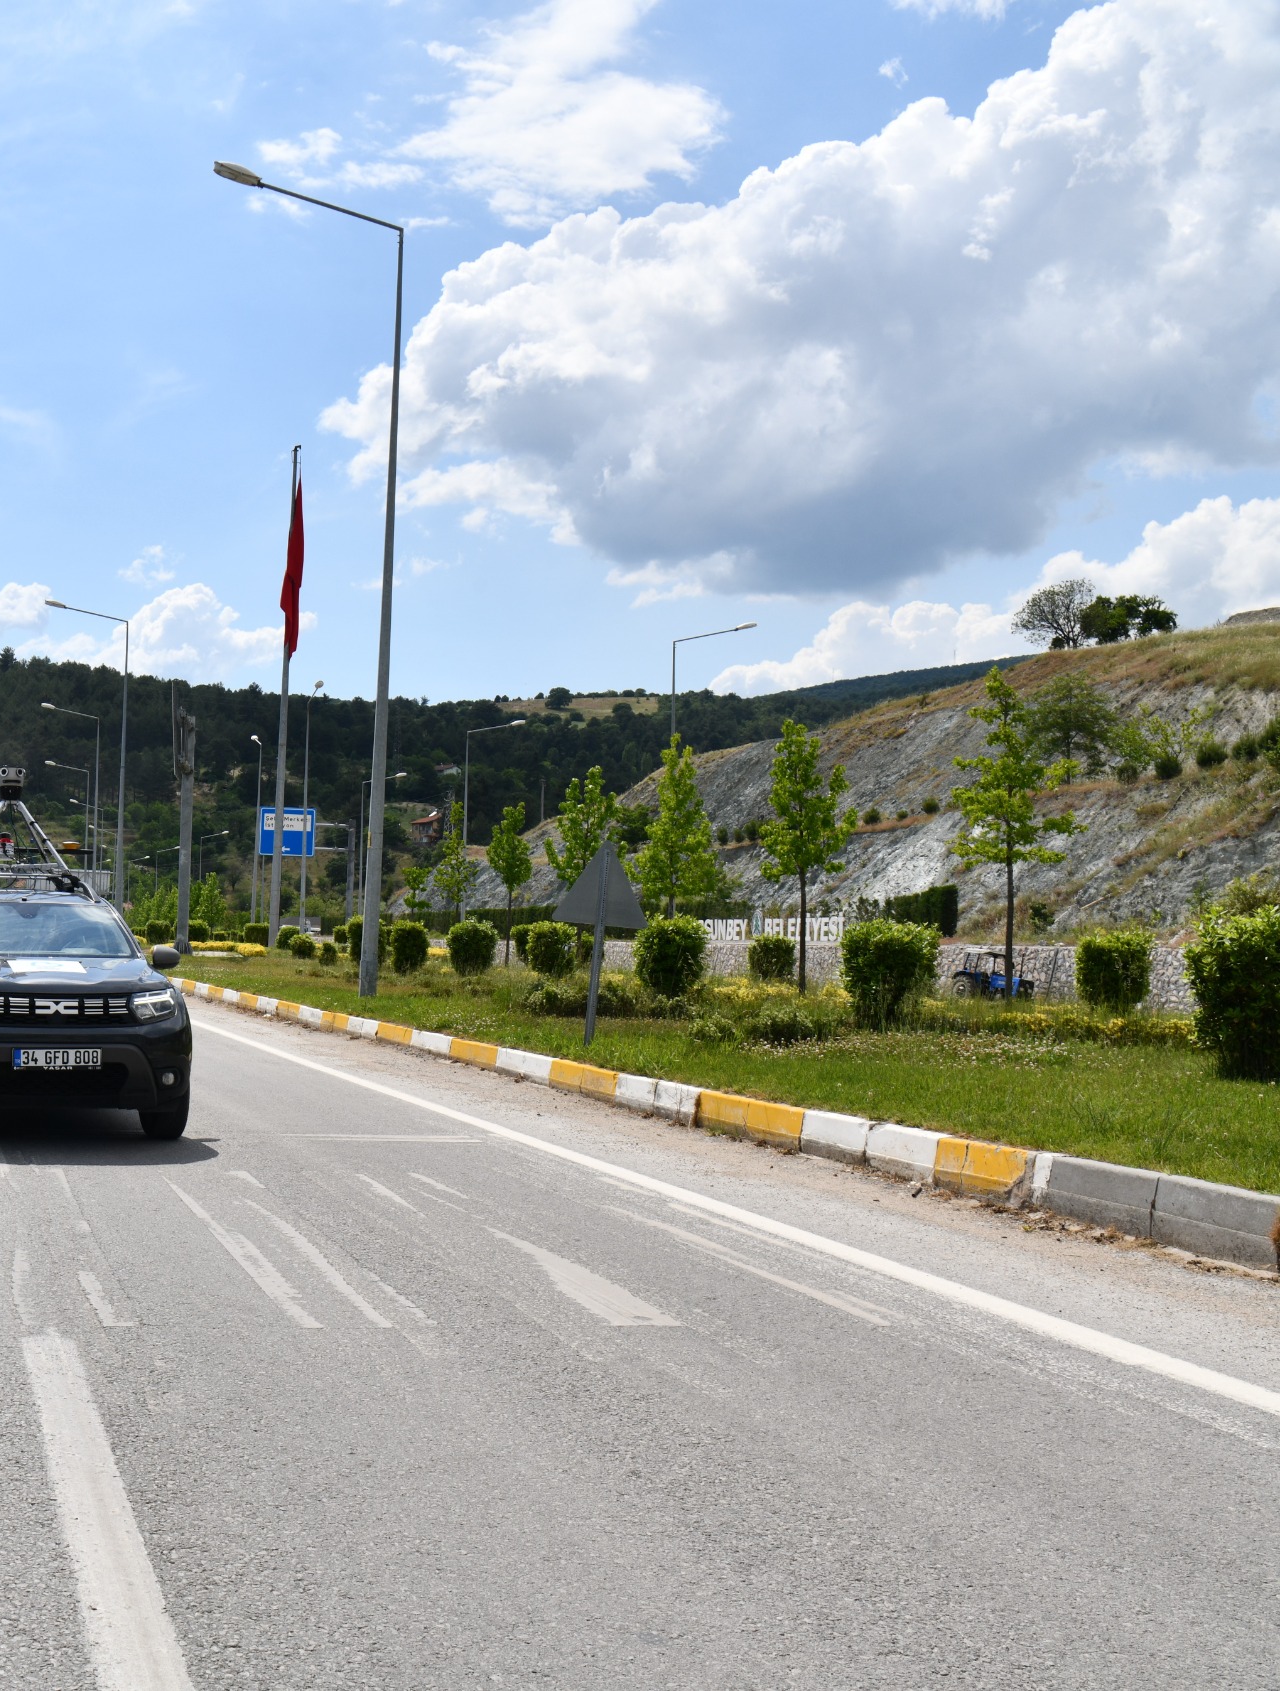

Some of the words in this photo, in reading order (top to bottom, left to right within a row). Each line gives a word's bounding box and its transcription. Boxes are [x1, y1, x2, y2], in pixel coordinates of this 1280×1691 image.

[22, 1050, 38, 1065] 34
[45, 1050, 69, 1065] GFD
[74, 1050, 99, 1065] 808
